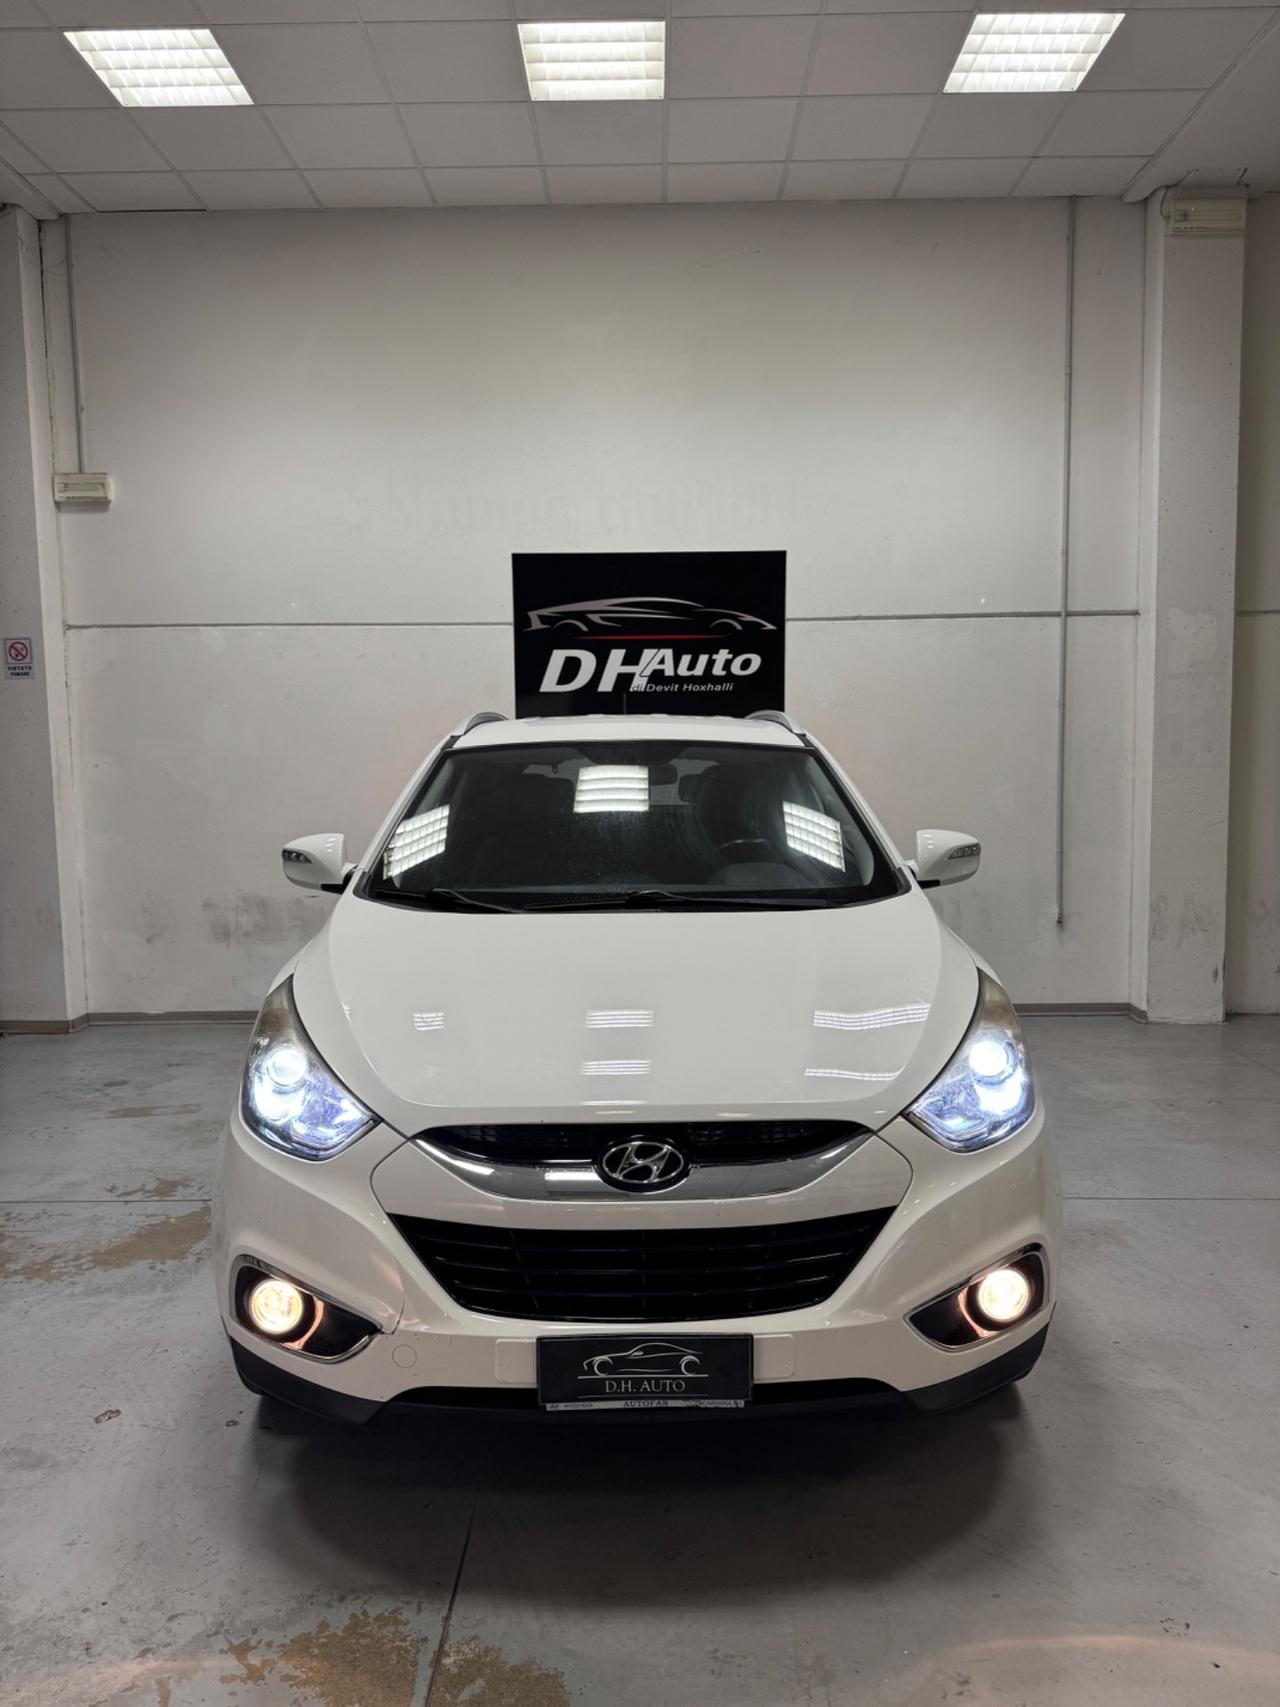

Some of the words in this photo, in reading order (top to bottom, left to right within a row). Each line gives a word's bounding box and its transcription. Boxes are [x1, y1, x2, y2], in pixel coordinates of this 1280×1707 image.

[646, 682, 680, 692] Devit
[682, 681, 735, 692] Hoxhalli
[605, 1380, 638, 1393] D.H.
[640, 1379, 686, 1392] AUTO
